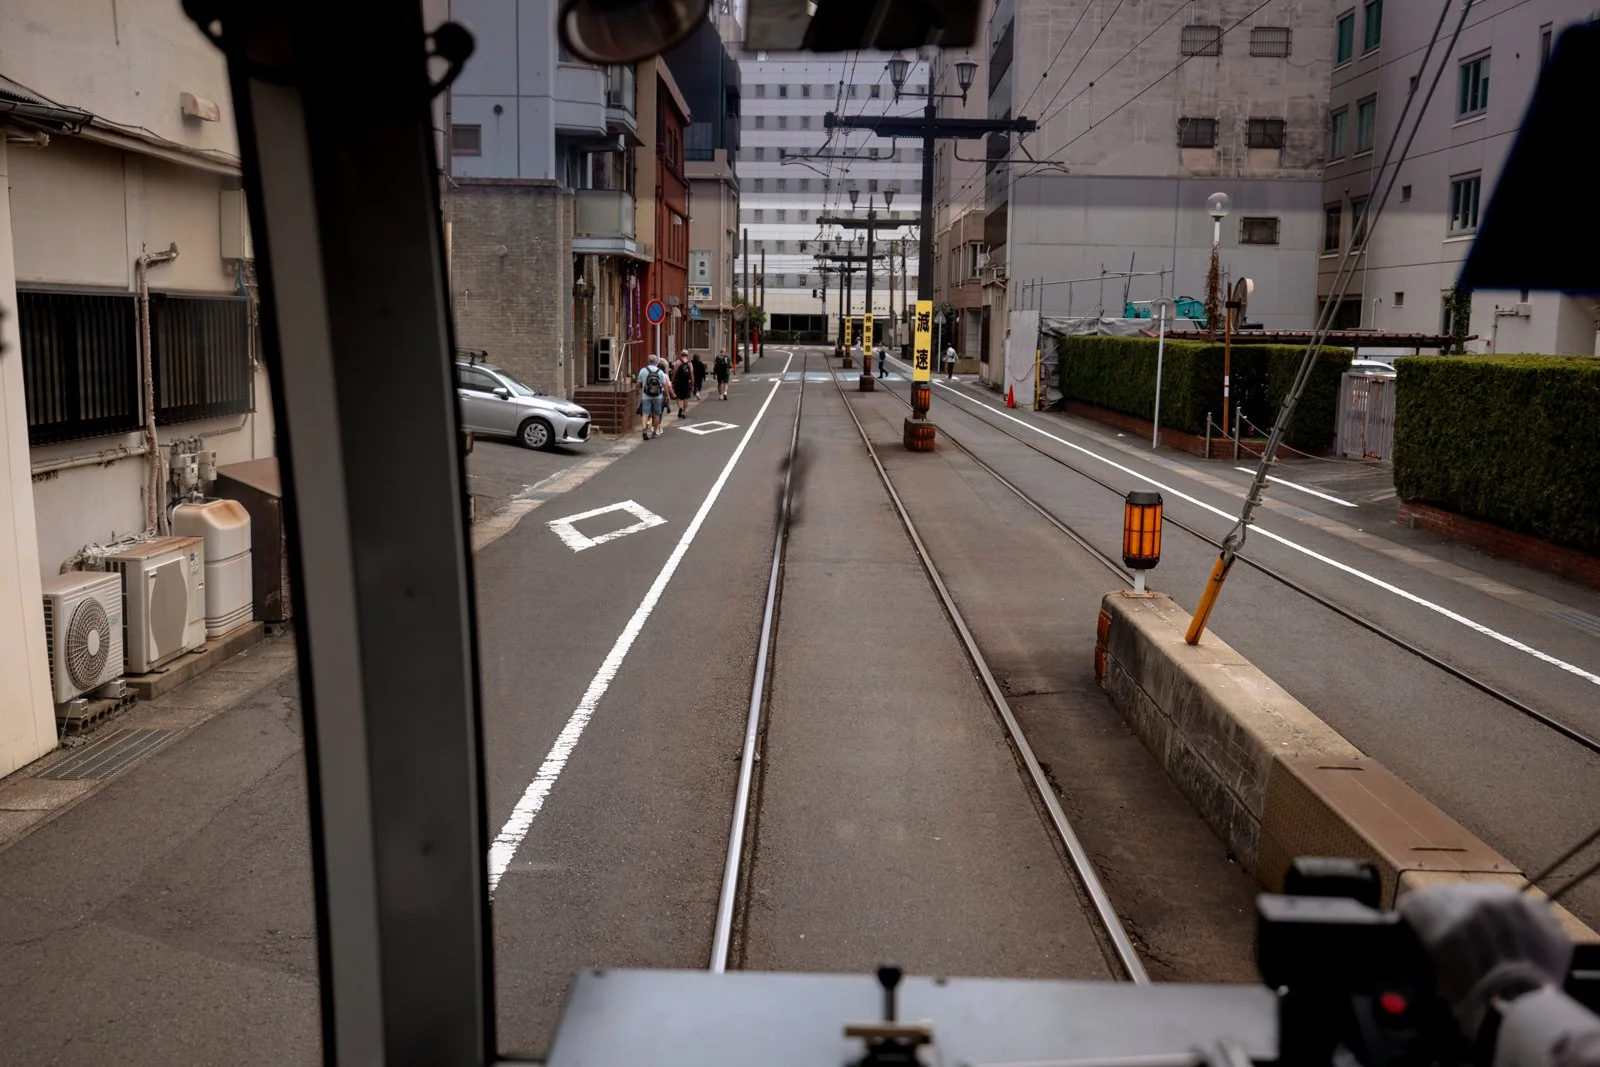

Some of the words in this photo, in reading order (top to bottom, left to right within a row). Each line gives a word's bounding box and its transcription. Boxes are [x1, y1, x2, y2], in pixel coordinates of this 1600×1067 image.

[864, 315, 872, 352] 横断注意
[916, 312, 930, 370] 減速
